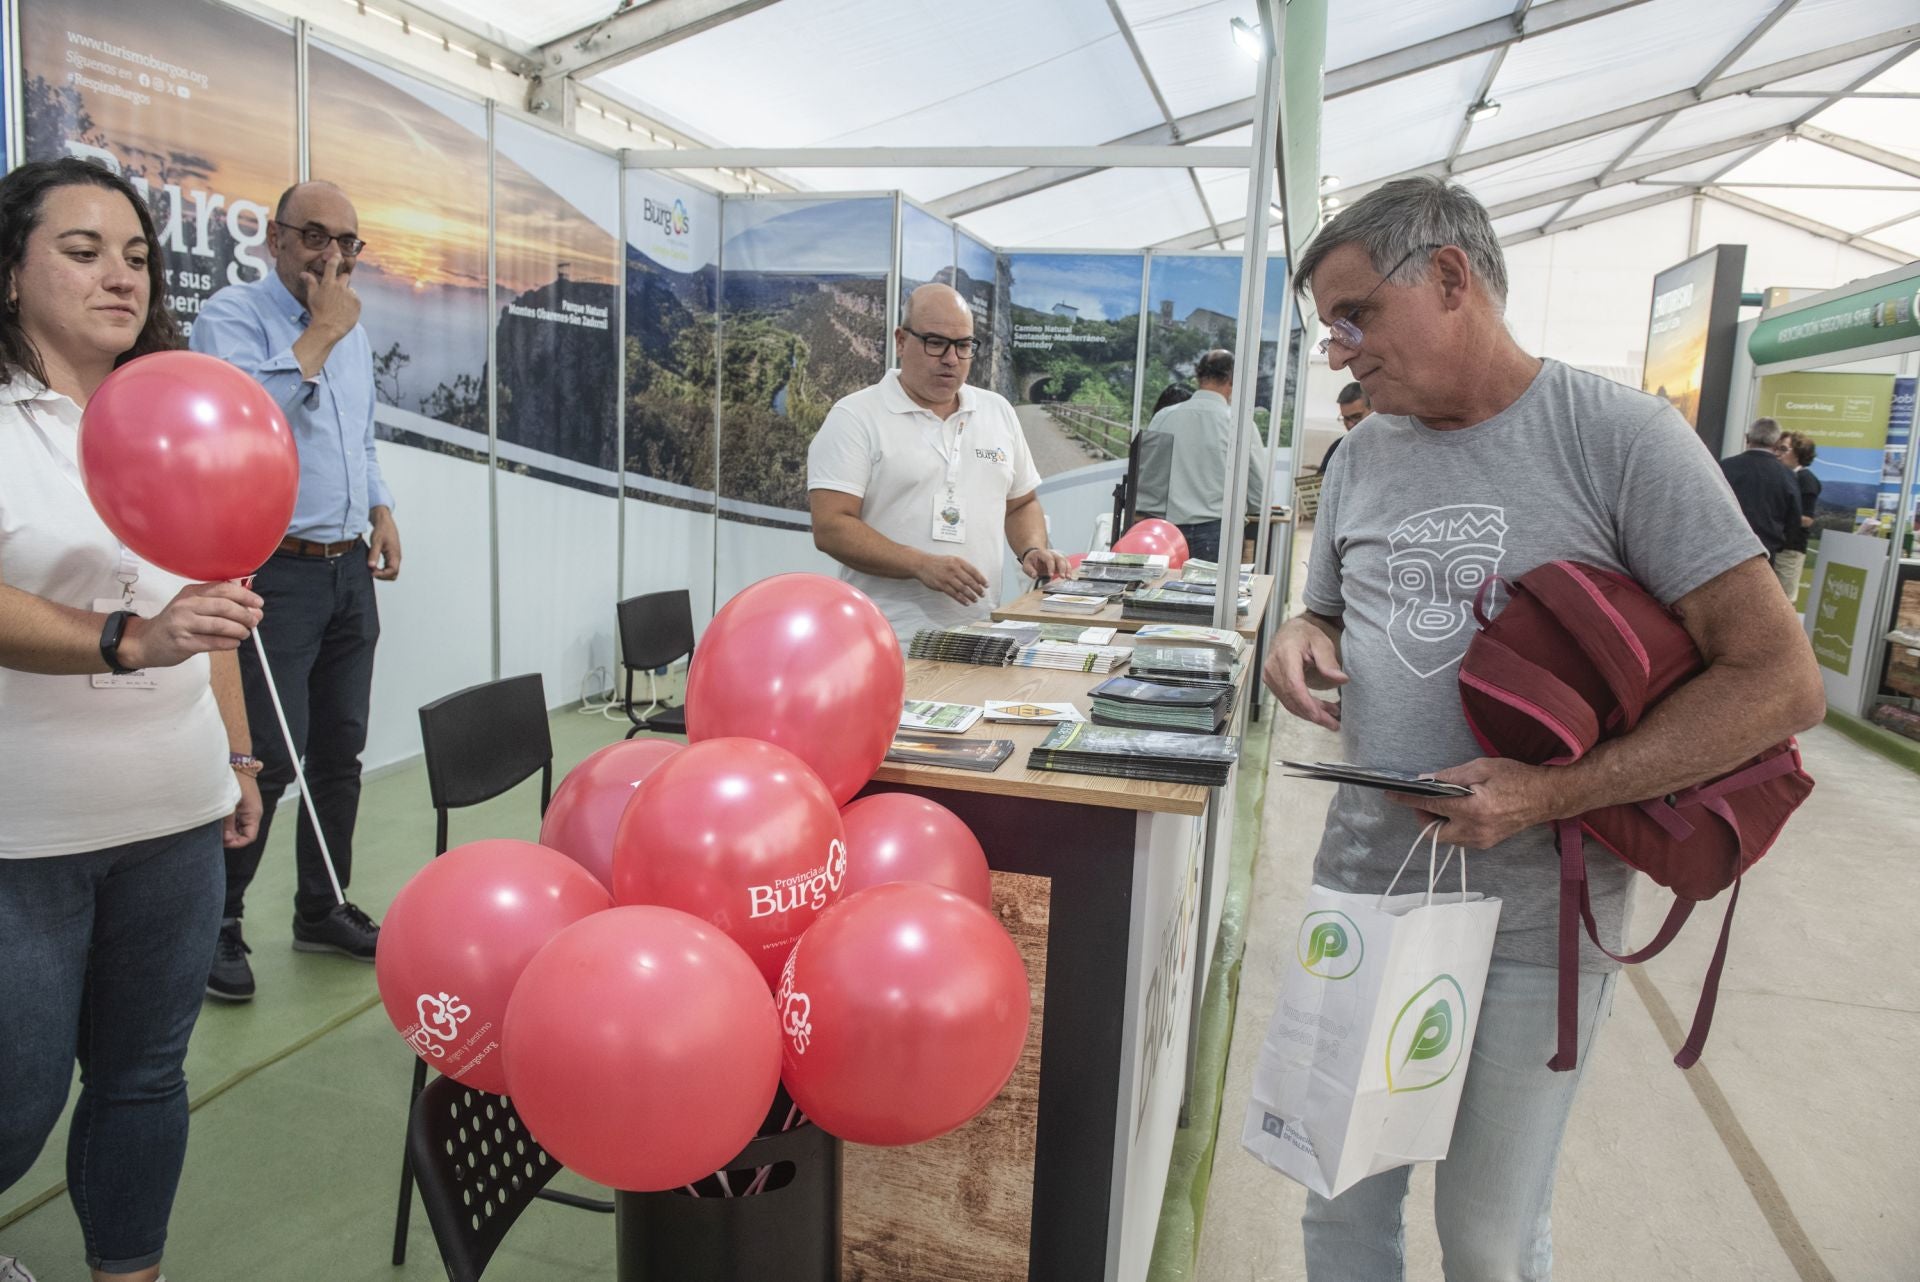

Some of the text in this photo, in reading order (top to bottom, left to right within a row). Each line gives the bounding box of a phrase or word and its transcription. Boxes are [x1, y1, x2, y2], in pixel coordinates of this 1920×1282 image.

[66, 31, 209, 90] www.turismoburgos.org
[118, 67, 132, 81] en
[179, 271, 212, 291] sus
[1013, 324, 1073, 334] Camino Natural
[1013, 340, 1054, 351] Puentedey
[1785, 401, 1835, 412] Coworking
[1825, 574, 1859, 601] Segovia
[775, 867, 818, 889] Provincia
[466, 1022, 492, 1047] destino
